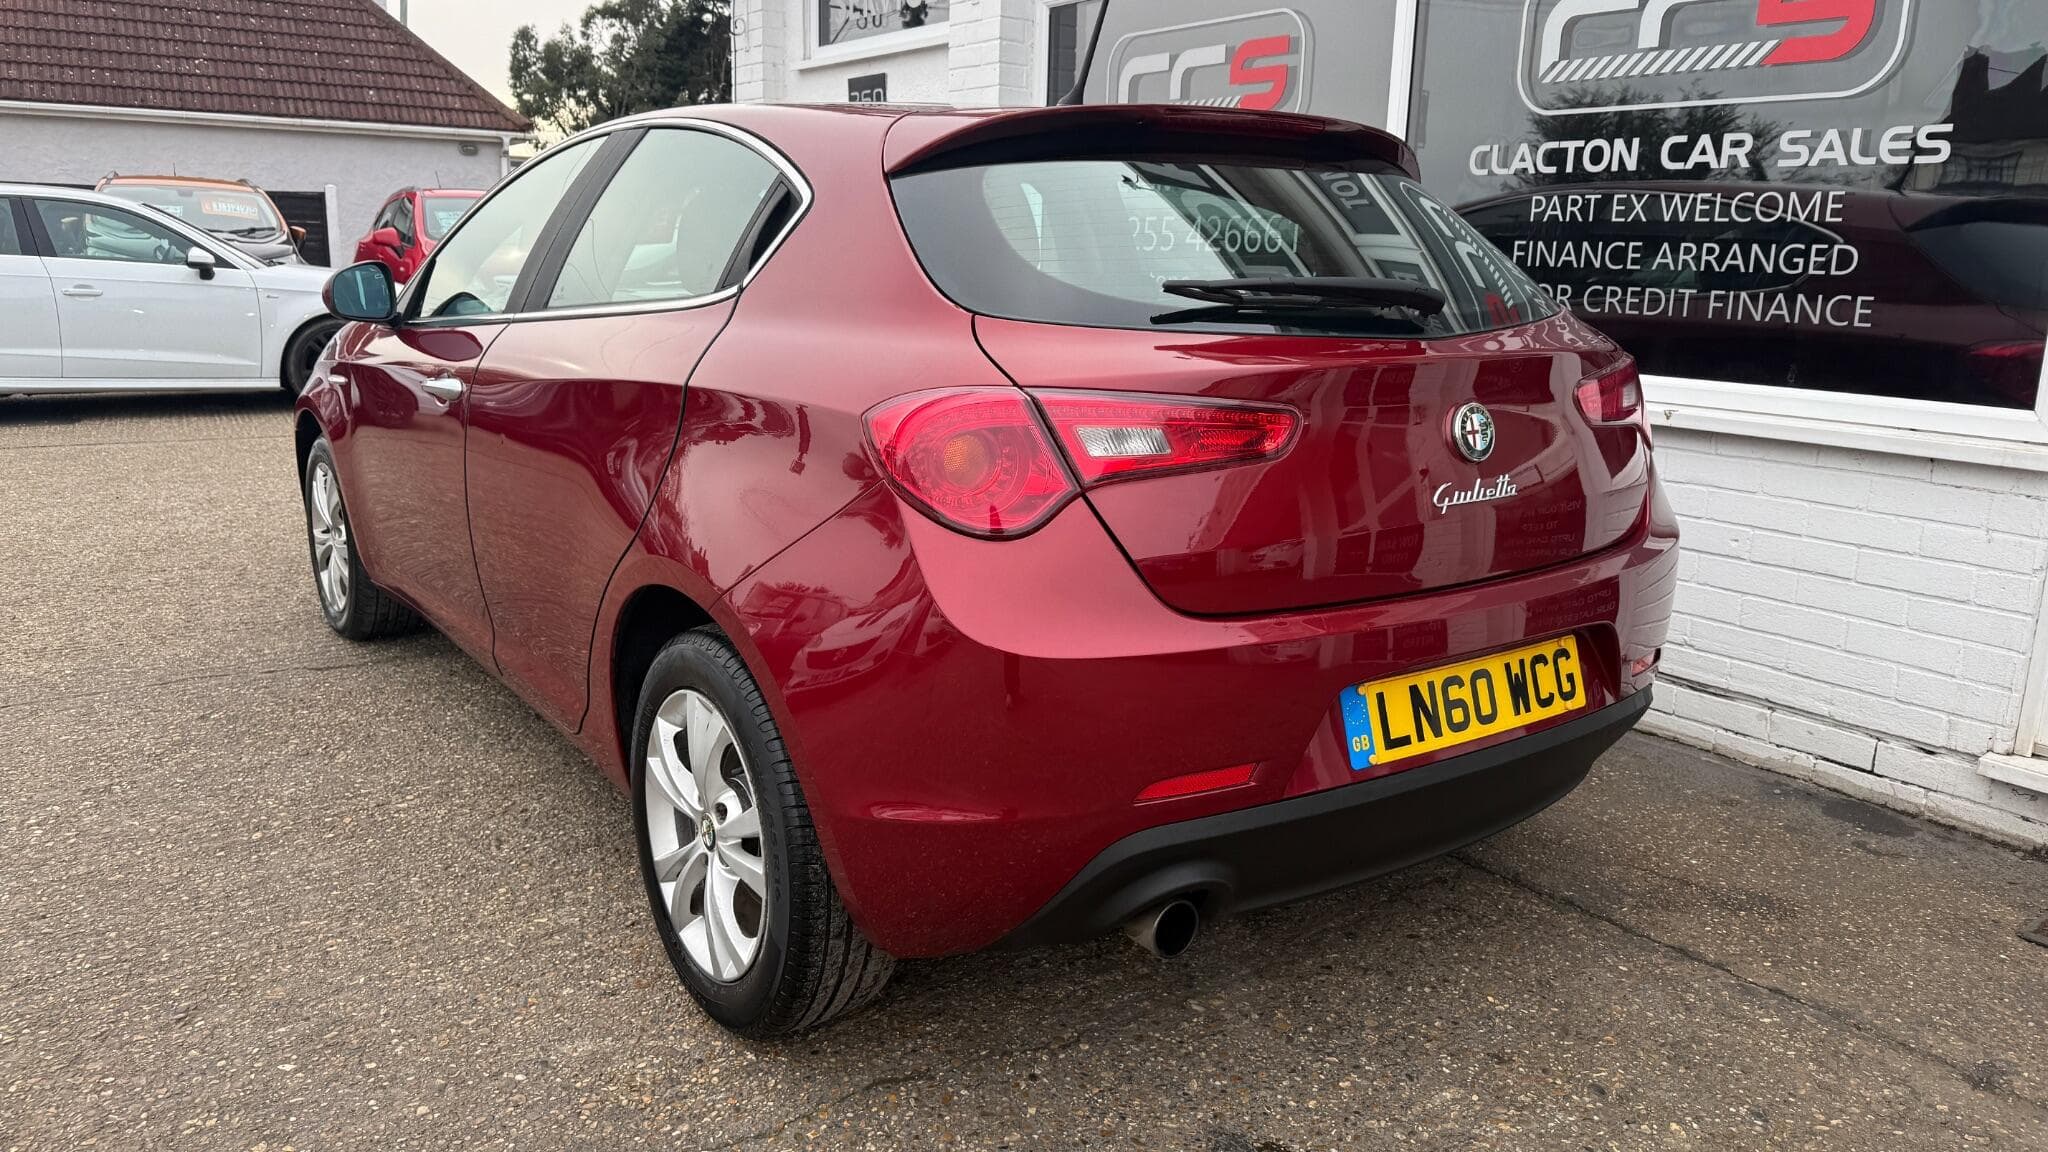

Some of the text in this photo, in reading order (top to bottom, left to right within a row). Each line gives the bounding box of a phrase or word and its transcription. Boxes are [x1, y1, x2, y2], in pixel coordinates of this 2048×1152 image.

[1469, 123, 1954, 176] CLACTON CAR SALES
[1530, 191, 1846, 223] PART EX WELCOME
[1513, 240, 1859, 276] FINANCE ARRANGED
[1583, 285, 1697, 317] CREDIT
[1708, 290, 1874, 327] FINANCE
[1433, 474, 1517, 514] Giulietta
[1376, 648, 1577, 750] LN60 WCG
[1352, 735, 1370, 752] GB
